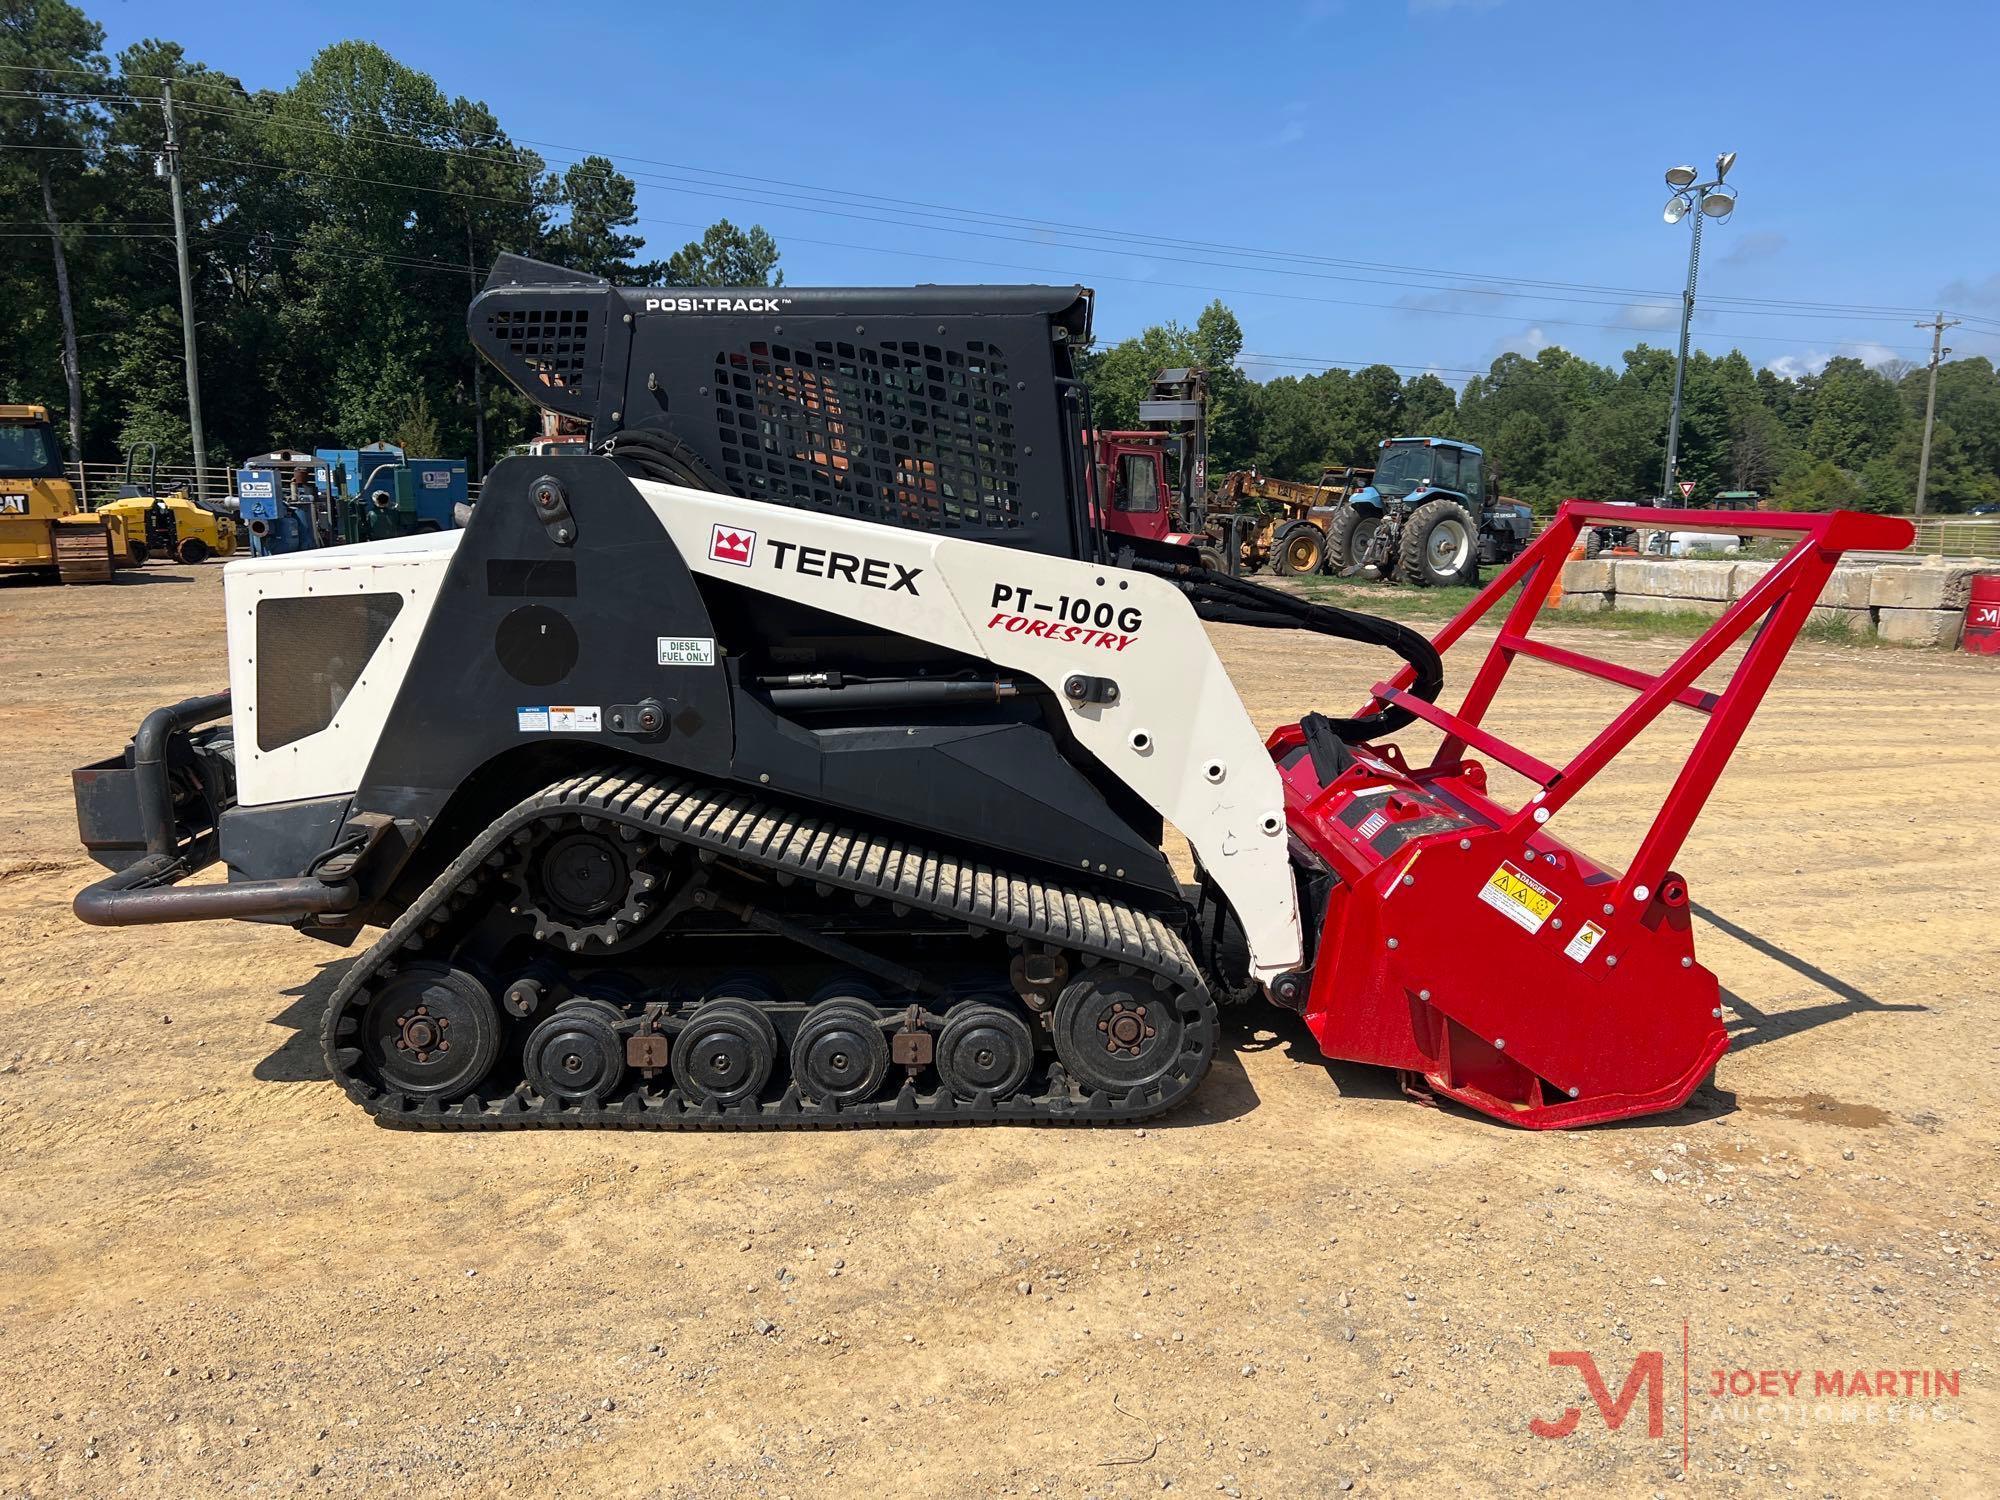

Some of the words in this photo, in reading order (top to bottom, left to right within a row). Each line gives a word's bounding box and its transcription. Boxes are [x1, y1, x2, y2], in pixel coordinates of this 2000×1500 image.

[767, 539, 924, 596] TEREX
[991, 583, 1142, 633] PT-100G
[670, 641, 701, 651] DIESEL
[987, 613, 1138, 651] FORESTRY
[662, 652, 684, 661] FUEL
[686, 652, 709, 662] ONLY
[1520, 874, 1547, 896] DANGER
